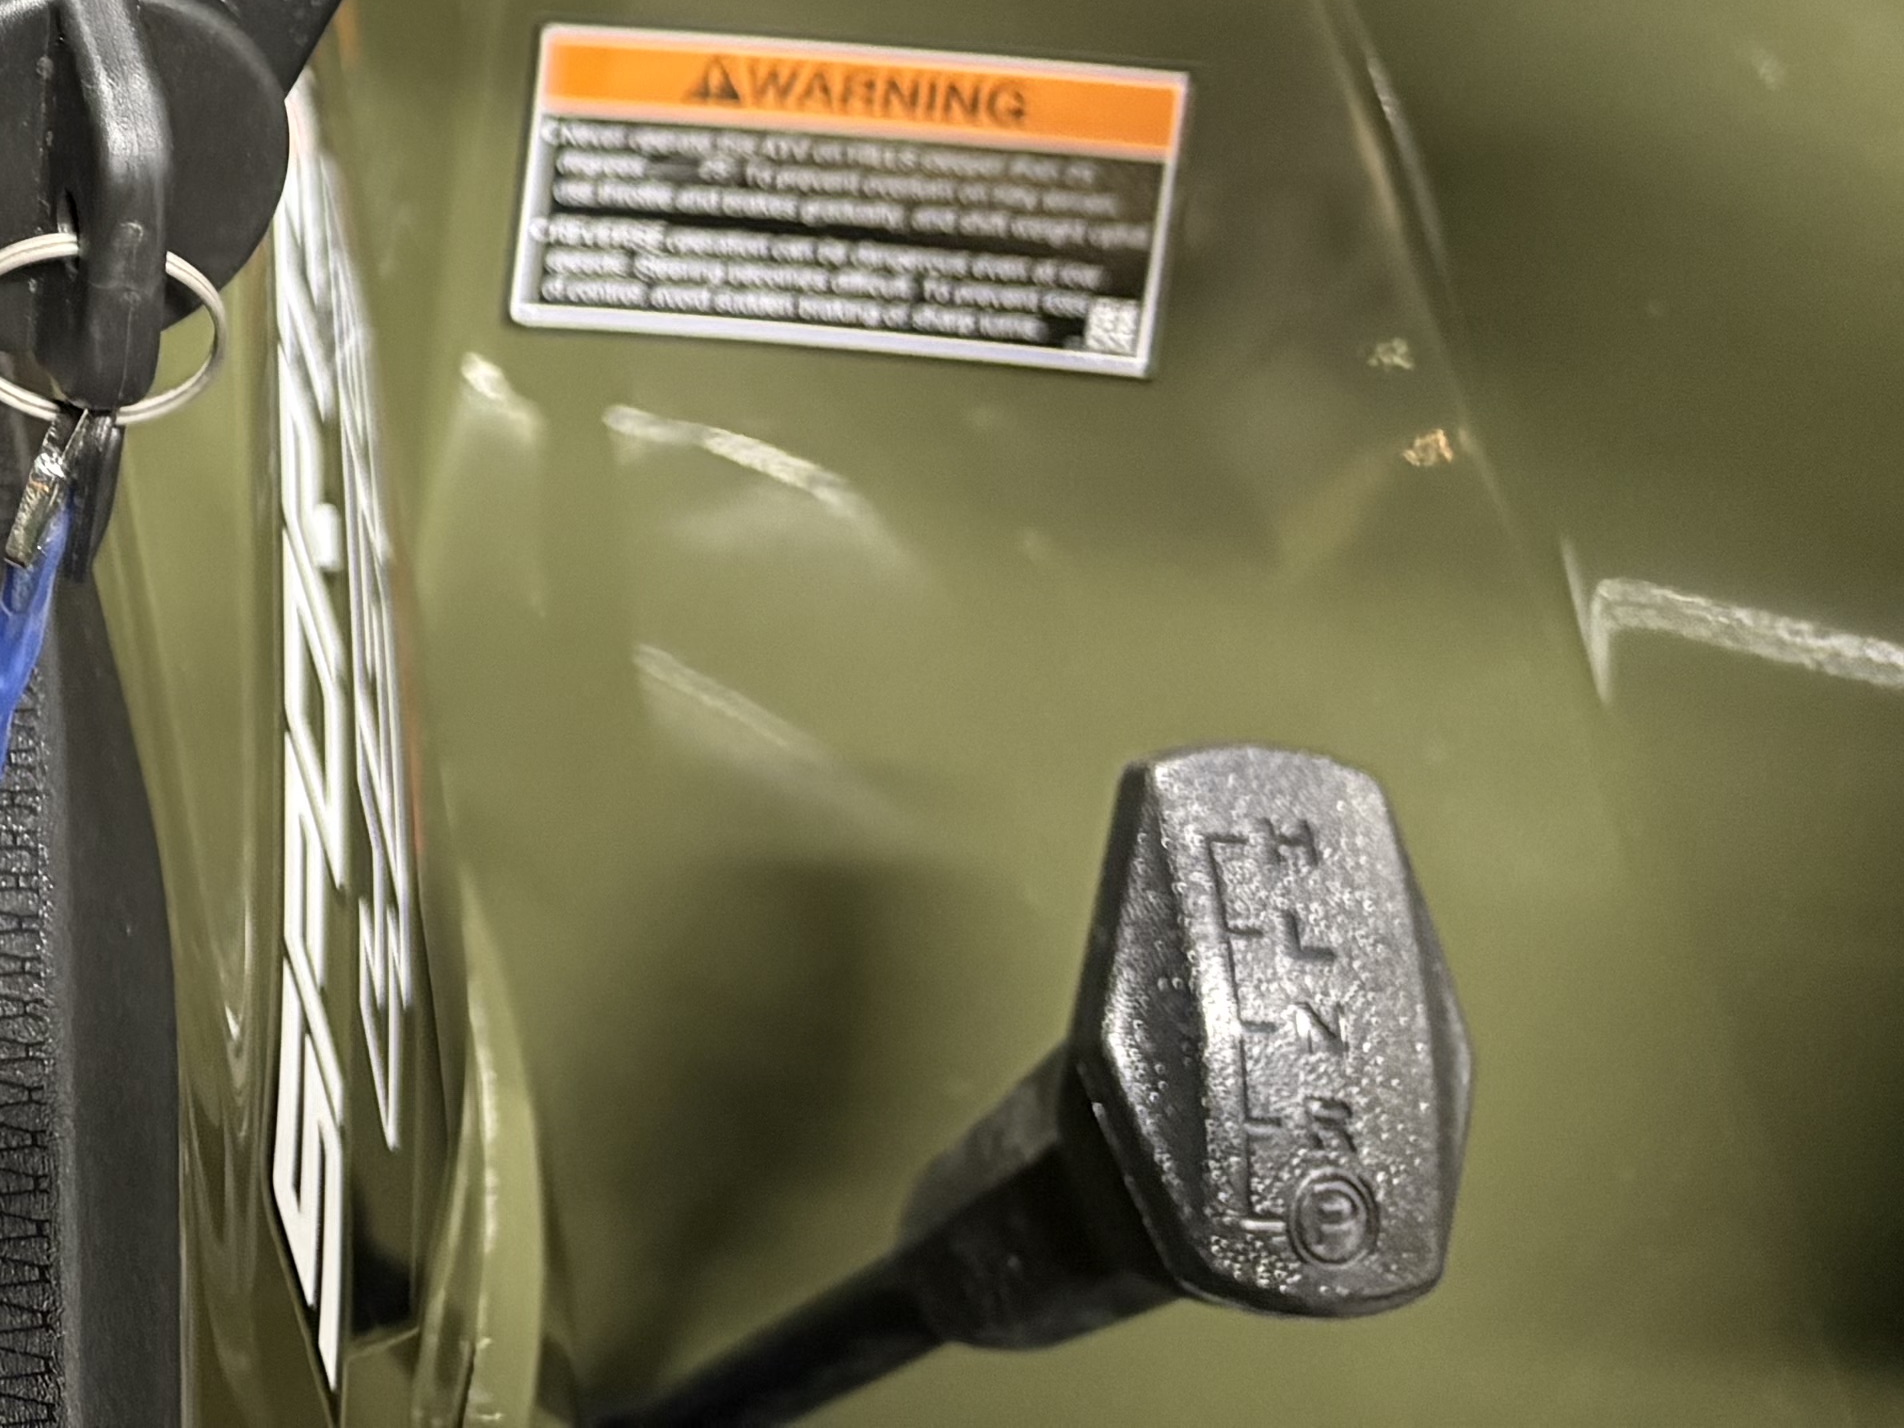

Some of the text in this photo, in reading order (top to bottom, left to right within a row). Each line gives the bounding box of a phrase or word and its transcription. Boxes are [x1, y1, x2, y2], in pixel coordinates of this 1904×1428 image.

[745, 60, 1030, 128] WARNING
[1256, 816, 1318, 867] H
[1286, 911, 1337, 961] L
[1294, 1000, 1349, 1052] N
[1304, 1096, 1357, 1152] R
